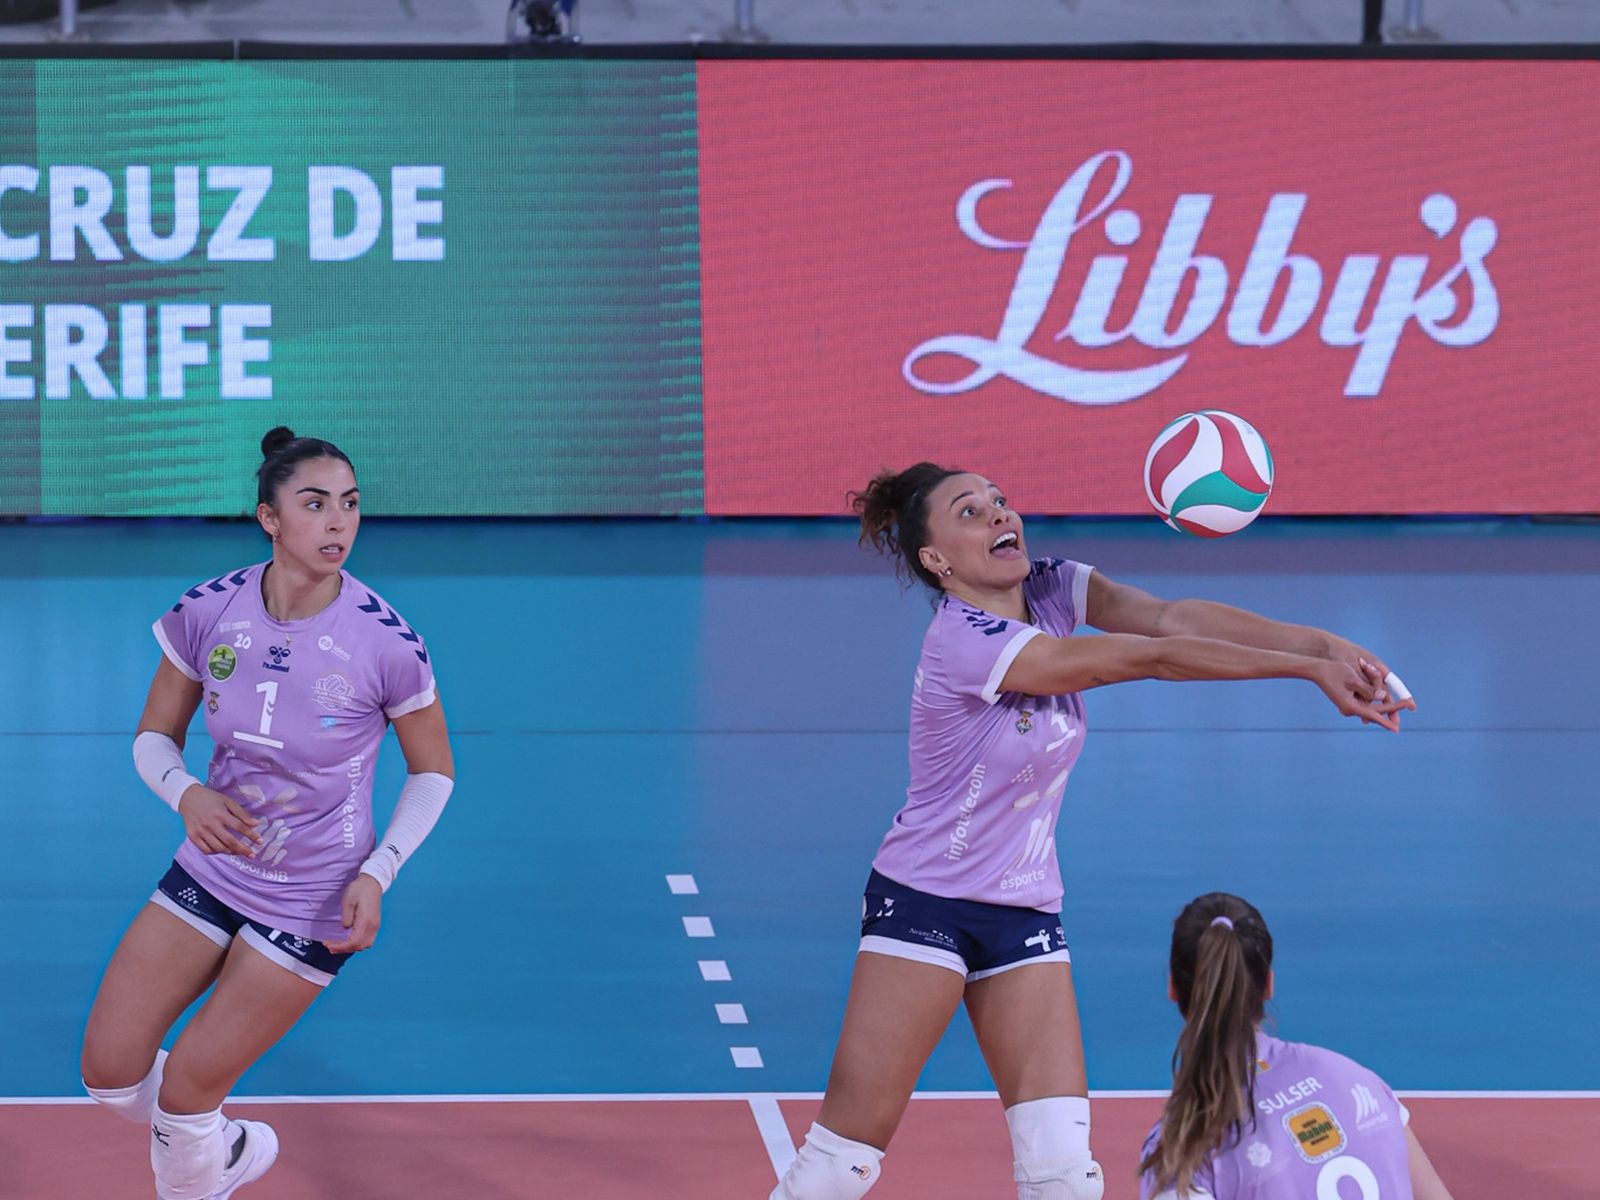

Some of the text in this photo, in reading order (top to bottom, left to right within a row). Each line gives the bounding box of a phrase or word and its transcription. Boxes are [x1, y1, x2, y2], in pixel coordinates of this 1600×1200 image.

[0, 164, 445, 263] CRUZ DE
[901, 150, 1500, 405] Libby's
[0, 304, 273, 399] ERIFE
[234, 633, 252, 650] 20
[256, 681, 278, 735] 1
[944, 763, 986, 861] infotelecom
[1258, 1077, 1323, 1115] SULSER
